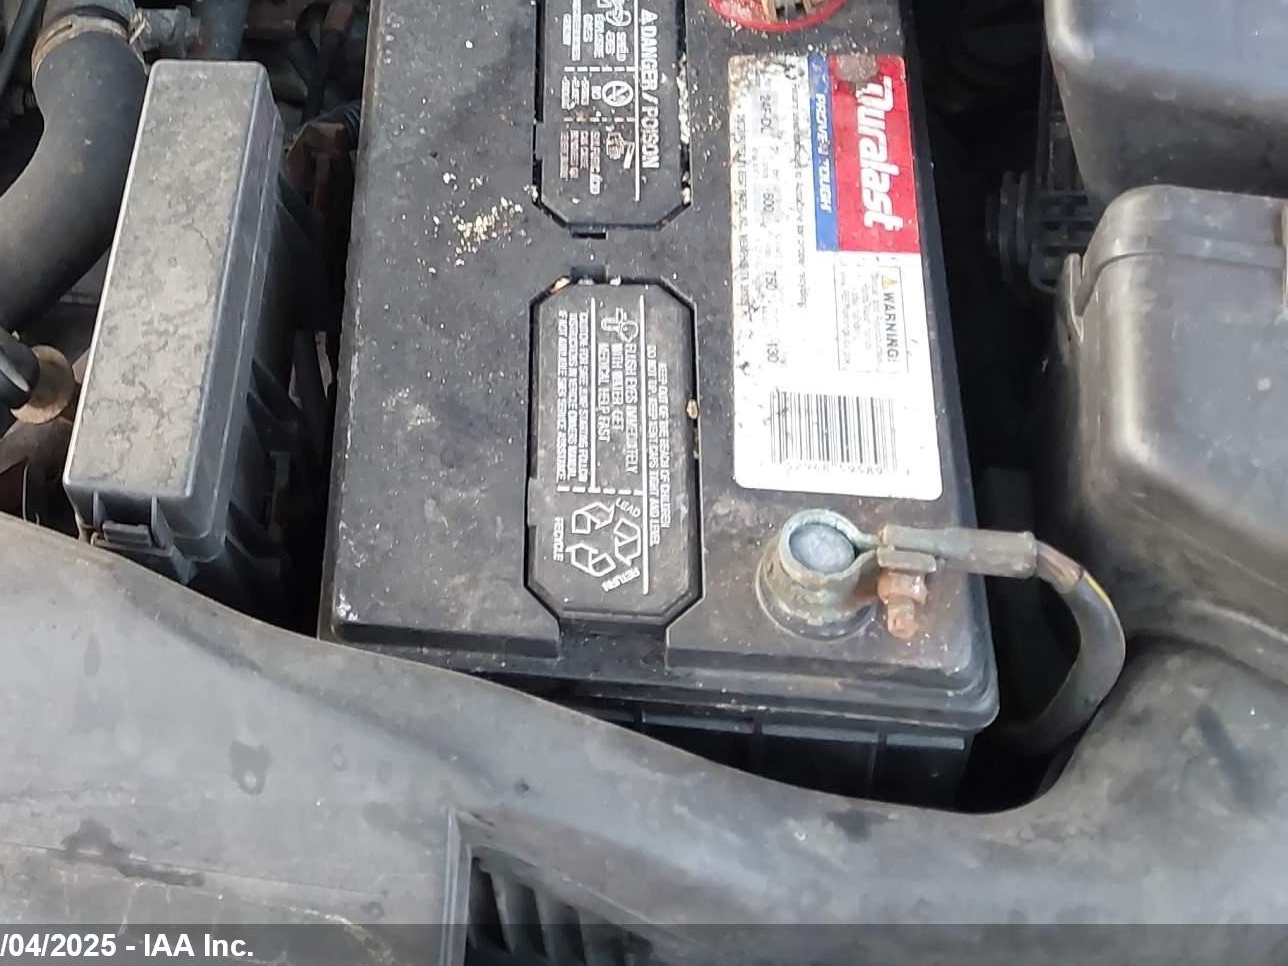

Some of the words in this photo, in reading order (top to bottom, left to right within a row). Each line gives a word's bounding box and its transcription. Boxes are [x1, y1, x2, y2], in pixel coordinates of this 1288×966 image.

[855, 75, 904, 232] Duralast
[818, 159, 832, 213] TOUGH
[765, 270, 779, 291] 750
[766, 342, 779, 363] 130
[598, 415, 610, 443] FAST
[614, 497, 641, 518] LEAD
[553, 517, 565, 563] RECYCLE
[601, 567, 641, 592] RETURN
